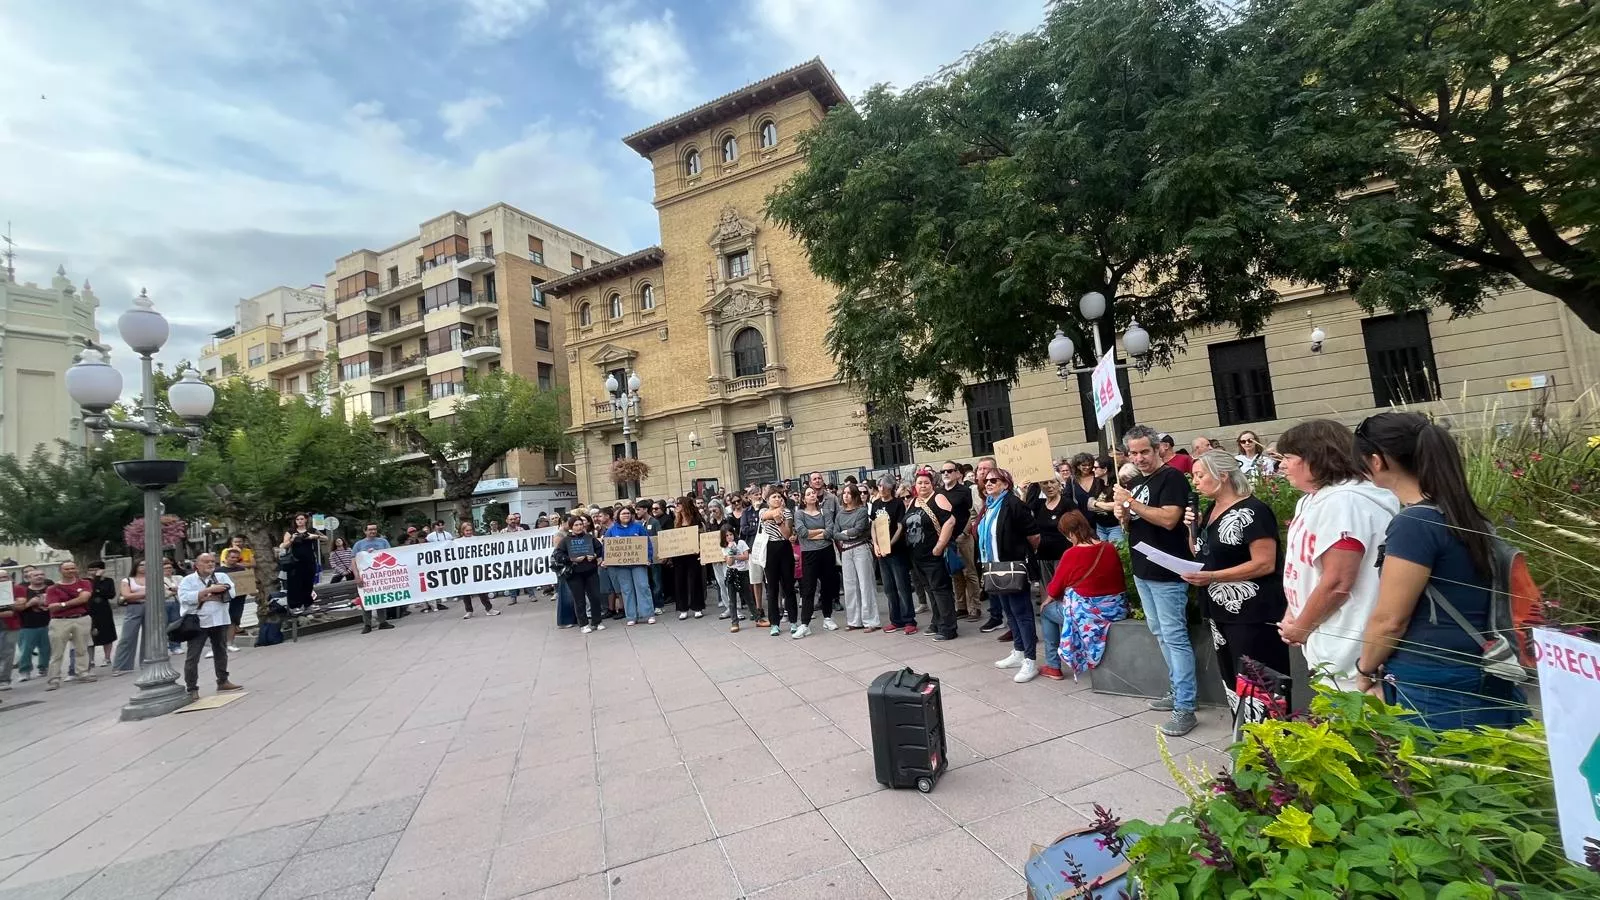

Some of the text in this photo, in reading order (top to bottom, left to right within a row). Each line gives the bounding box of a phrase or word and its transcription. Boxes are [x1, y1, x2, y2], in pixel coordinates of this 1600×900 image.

[417, 549, 442, 566] POR
[444, 547, 457, 562] EL
[457, 541, 505, 560] DERECHO
[507, 540, 515, 554] A
[516, 538, 529, 553] LA
[361, 567, 409, 580] PLATAFORMA
[372, 575, 410, 586] AFECTADOS
[419, 565, 469, 593] ¡STOP
[383, 582, 410, 591] HIPOTECA
[364, 589, 411, 606] HUESCA
